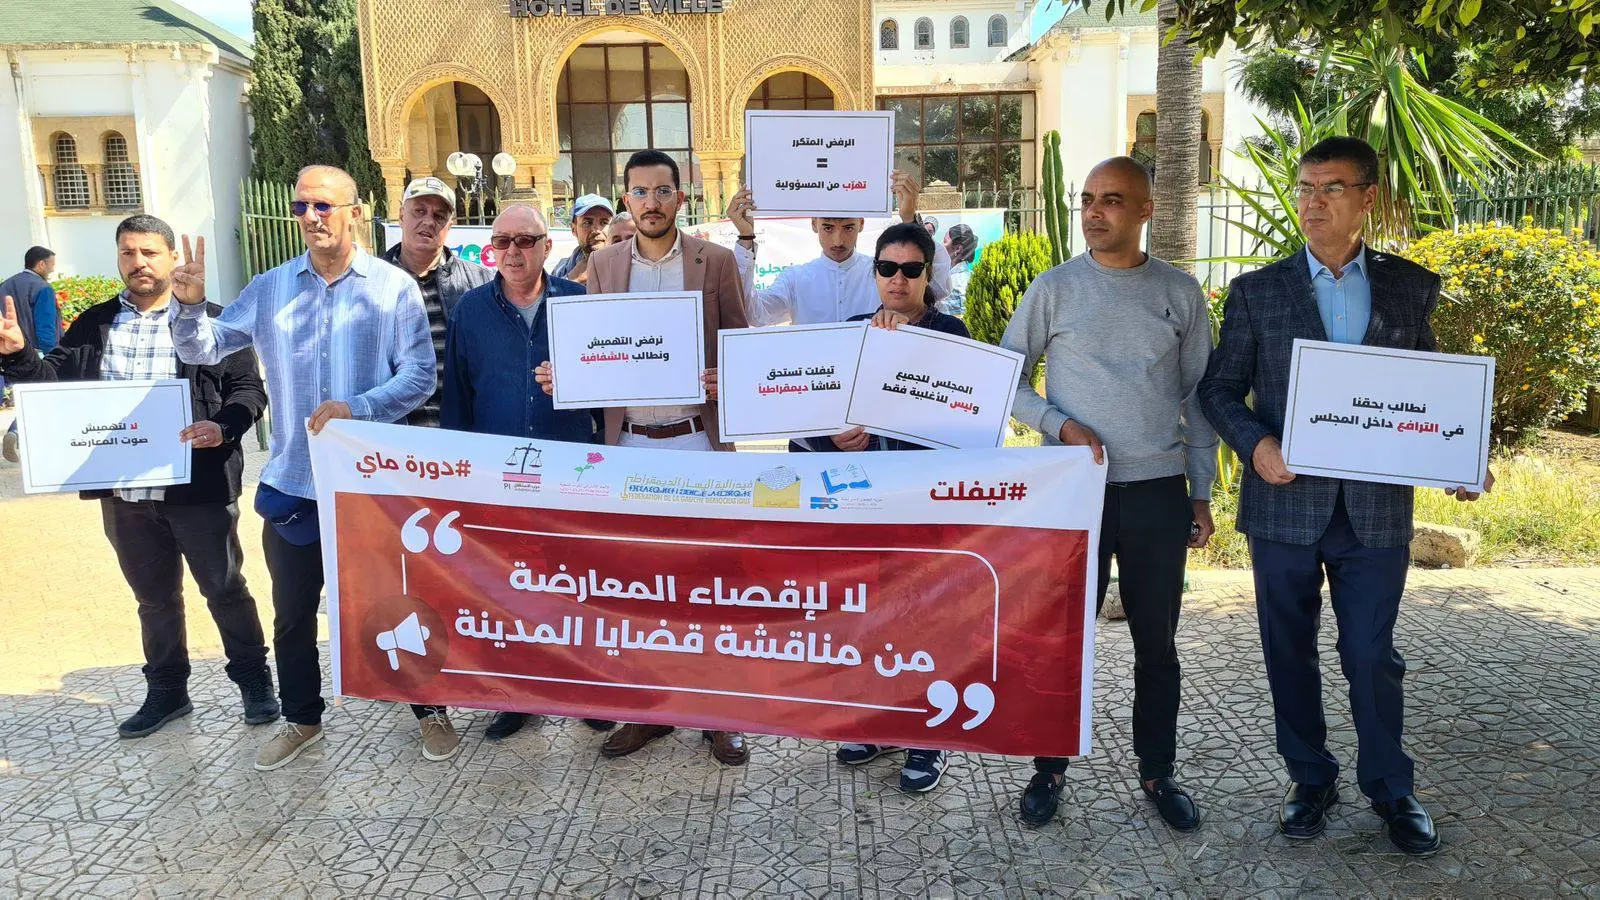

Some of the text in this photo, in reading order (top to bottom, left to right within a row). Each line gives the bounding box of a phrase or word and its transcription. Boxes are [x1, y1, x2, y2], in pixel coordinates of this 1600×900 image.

[605, 0, 641, 15] DE
[648, 0, 723, 14] VILLE
[792, 137, 855, 149] الرفض المتكرر
[775, 179, 824, 191] المسؤولية
[826, 181, 840, 191] من
[587, 335, 663, 349] نرفض التهميش
[580, 350, 670, 365] ونطالب بالشفافية
[766, 365, 835, 381] تيفلت تستحق
[895, 371, 974, 395] المجلس للجميع
[881, 382, 980, 415] وليس للأغلبية فقط
[1352, 396, 1427, 414] نطالب بحقنا
[81, 421, 138, 435] لا لتهميش
[1309, 412, 1465, 441] في الترافع داخل المجلس
[70, 436, 149, 448] صوت المعارضة
[355, 451, 400, 479] ماي
[929, 480, 1028, 506] #تيفلت
[509, 561, 867, 621] لا لإقصاء المعارضة
[455, 608, 935, 678] من مناقشة قضايا المدينة
